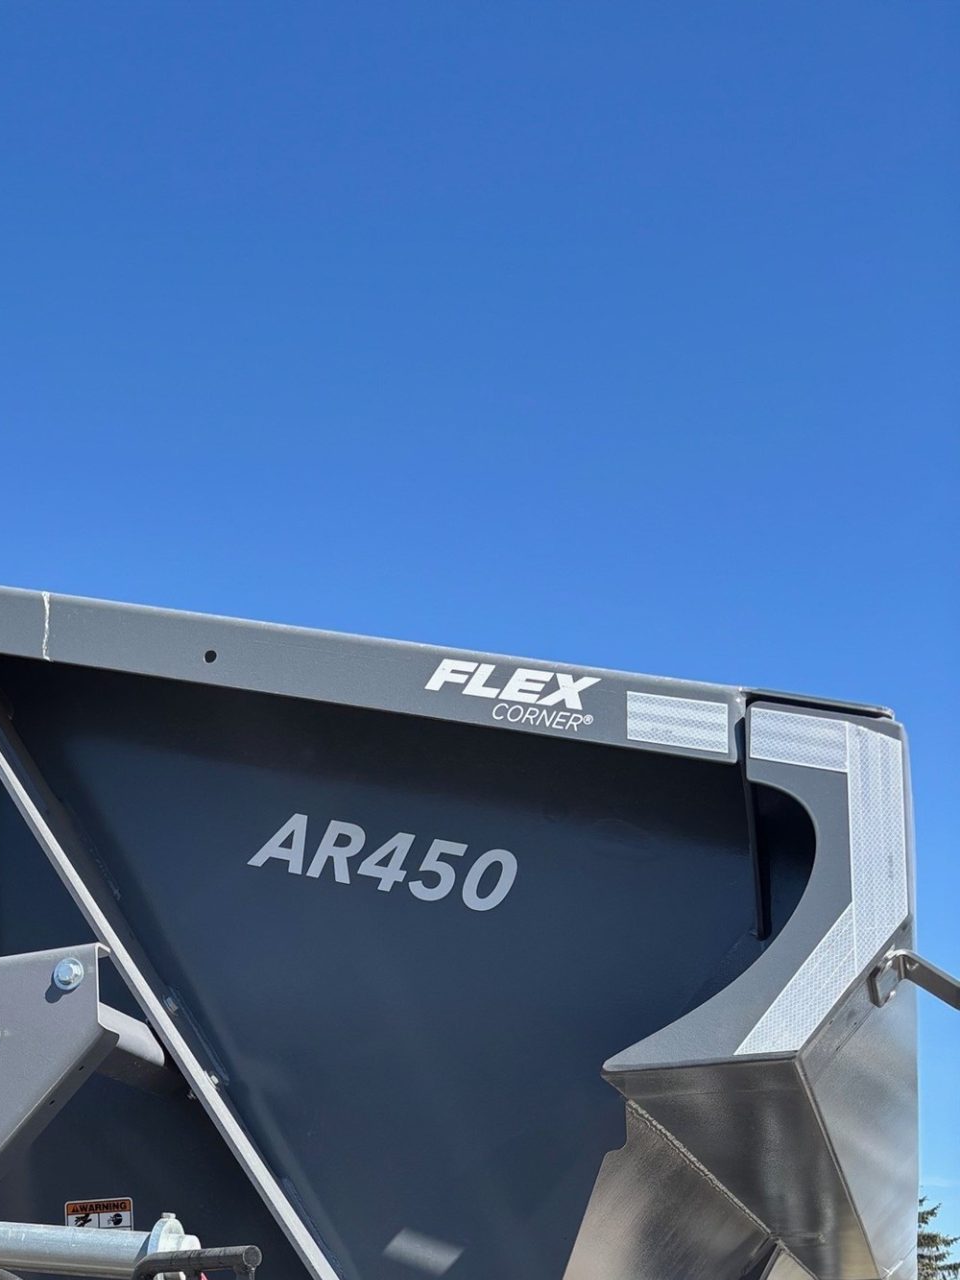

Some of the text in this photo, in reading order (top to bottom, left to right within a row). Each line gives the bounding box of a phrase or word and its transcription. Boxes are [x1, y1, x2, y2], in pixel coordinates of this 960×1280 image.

[425, 658, 602, 711] FLEX
[247, 813, 519, 913] AR450
[79, 1201, 127, 1213] WARNING
